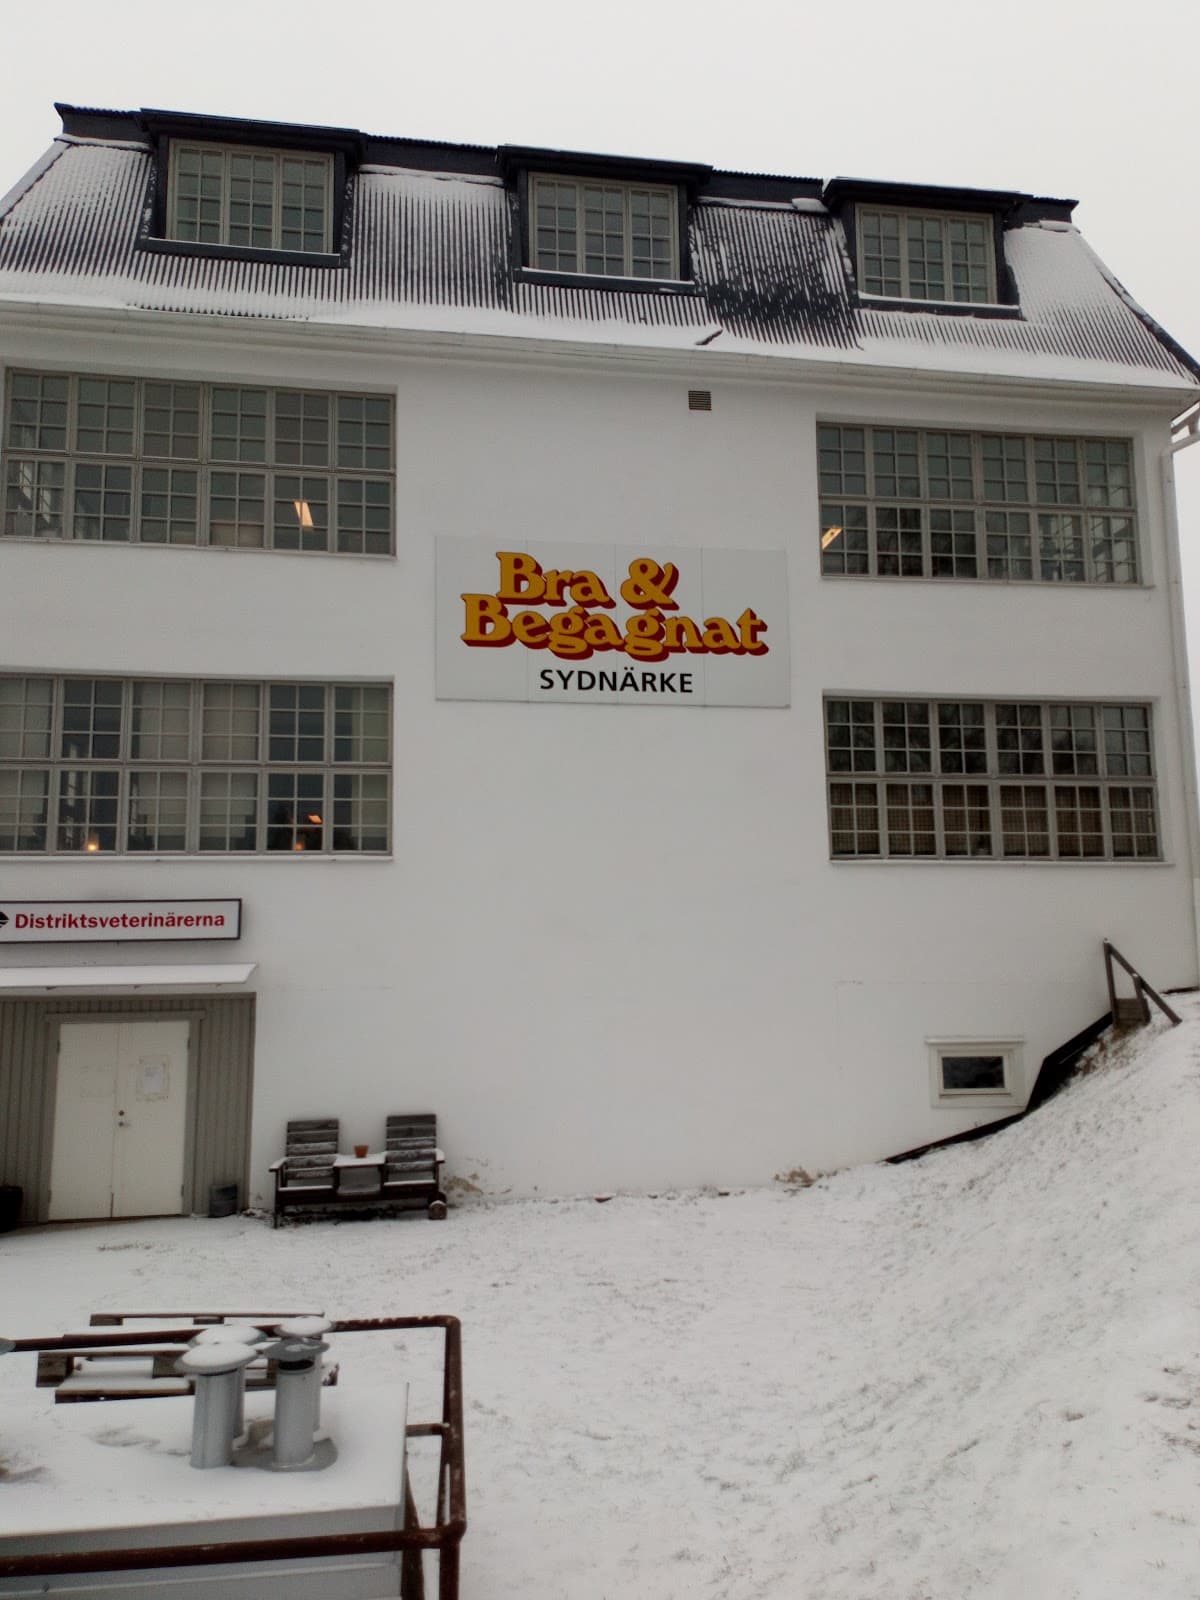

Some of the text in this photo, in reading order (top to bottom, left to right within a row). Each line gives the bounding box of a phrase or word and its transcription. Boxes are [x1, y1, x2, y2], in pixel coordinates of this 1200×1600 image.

[496, 552, 680, 611] Bra &
[460, 593, 769, 662] Begagnat
[540, 667, 693, 693] SYDNÄRKE
[15, 912, 225, 929] Distriktsveterinärerna
